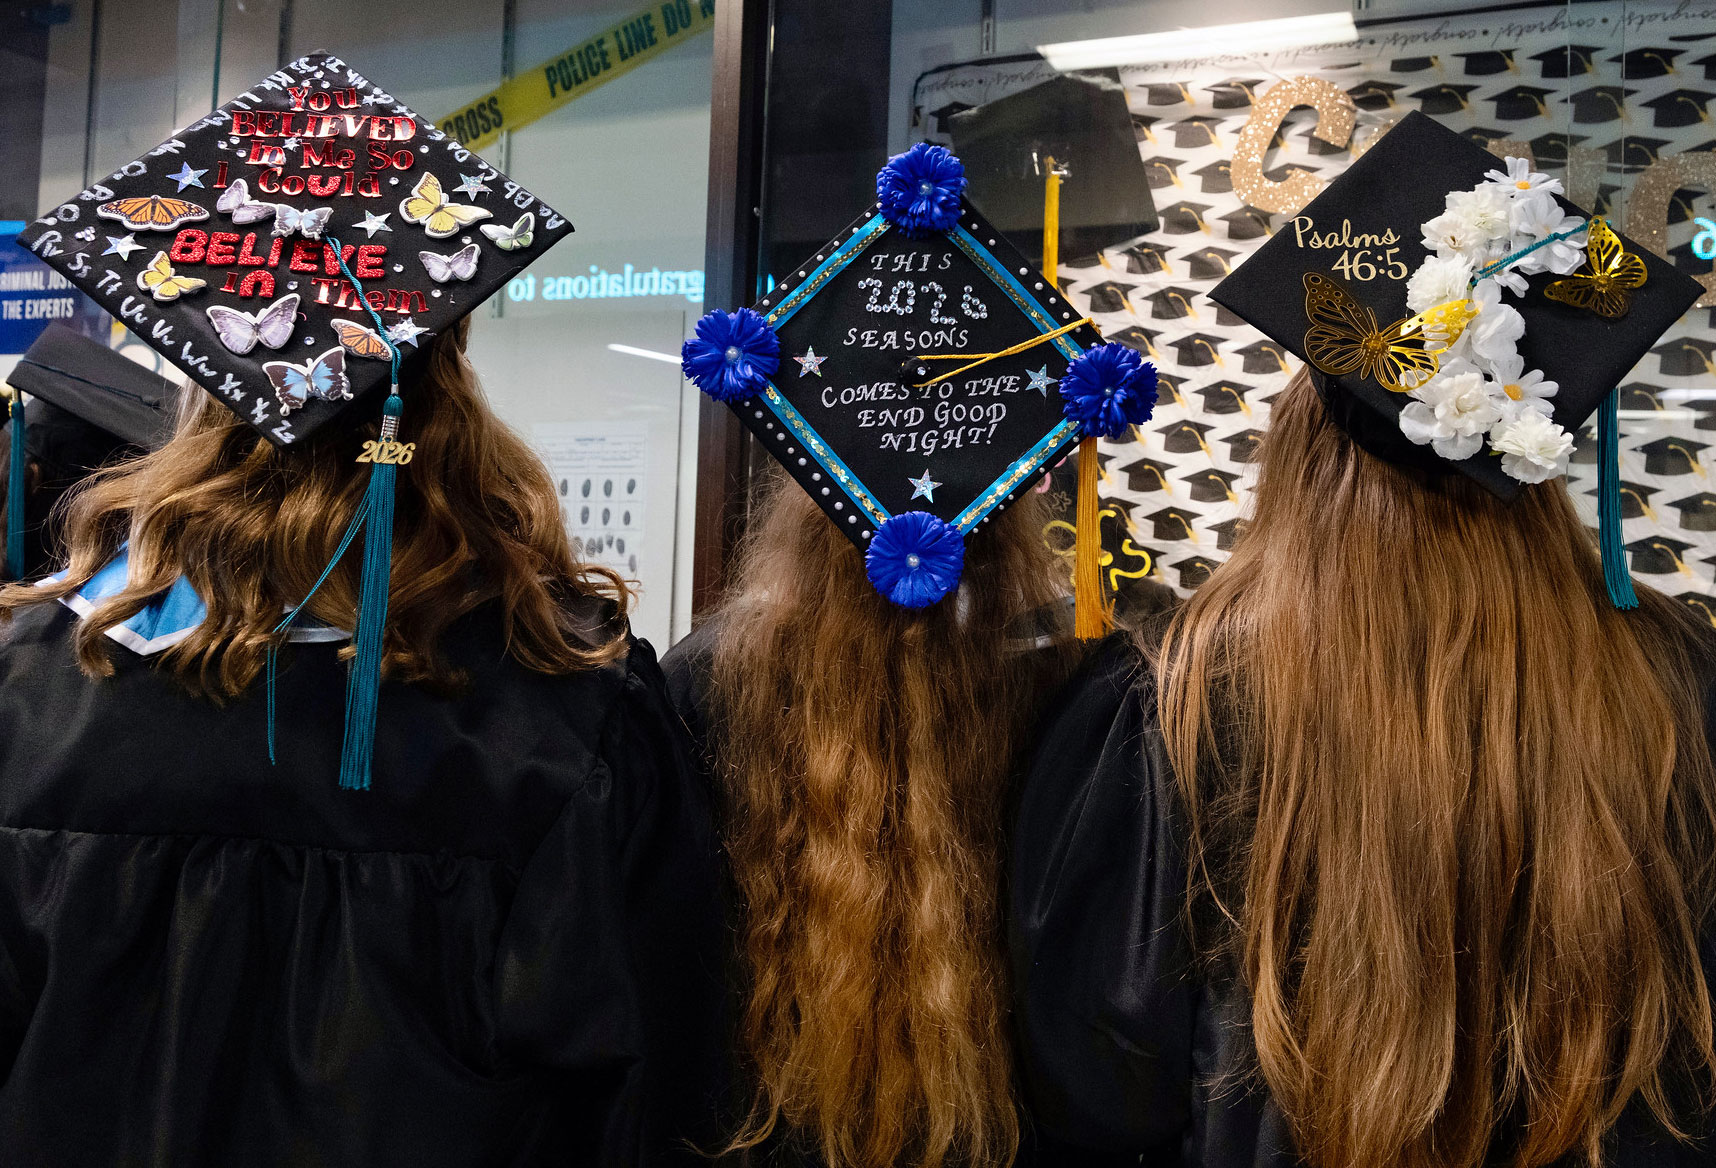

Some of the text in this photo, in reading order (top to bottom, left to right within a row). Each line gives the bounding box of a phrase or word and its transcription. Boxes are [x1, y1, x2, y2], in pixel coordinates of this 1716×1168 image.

[544, 37, 612, 98] POLICE
[614, 12, 658, 62] LINE
[287, 85, 361, 111] You
[228, 110, 416, 141] BELIEVED
[245, 139, 414, 170] In Me So
[213, 161, 228, 188] I
[1288, 216, 1401, 249] Psalms
[170, 228, 388, 279] BELIEVE
[870, 251, 952, 273] THIS
[1331, 247, 1408, 281] 46:5
[2, 298, 74, 320] THE EXPERTS
[311, 277, 429, 314] Them
[858, 277, 988, 325] 2026
[843, 327, 969, 350] SEASONS
[821, 375, 1020, 408] COMES TO THE
[857, 400, 1007, 429] END GOOD
[355, 440, 416, 465] 2026
[879, 423, 998, 456] NIGHT!
